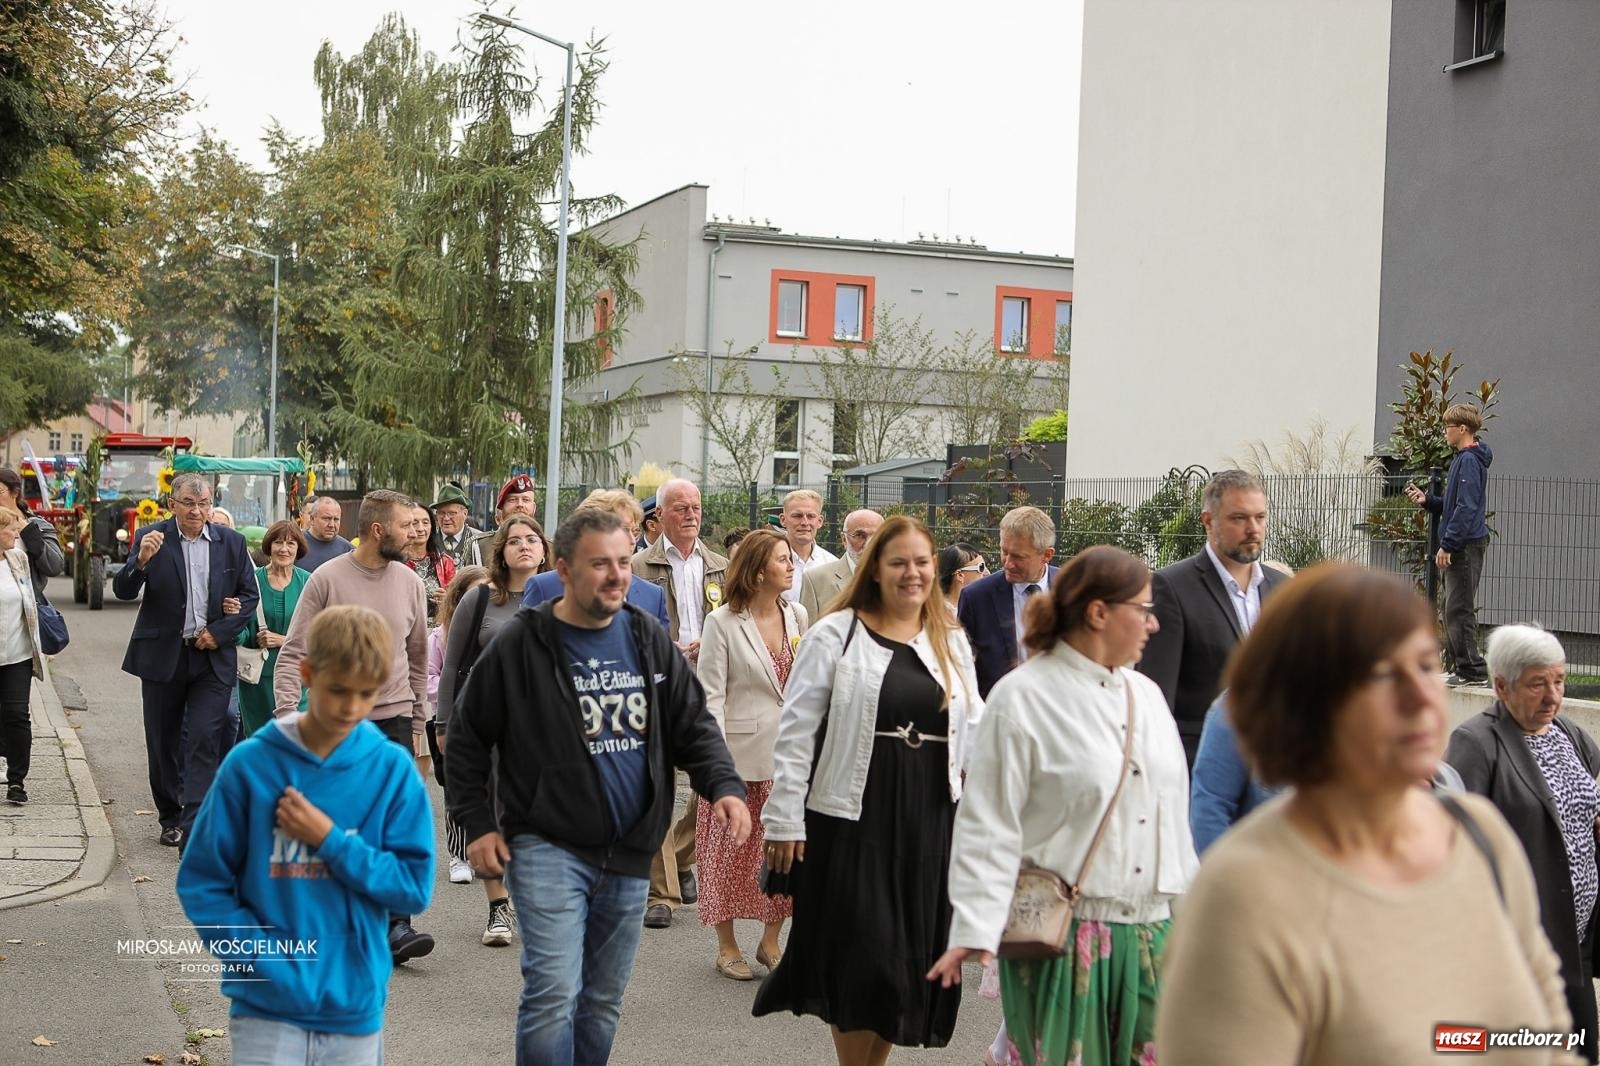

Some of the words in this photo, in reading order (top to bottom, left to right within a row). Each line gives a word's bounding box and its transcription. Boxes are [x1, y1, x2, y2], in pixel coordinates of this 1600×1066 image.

[573, 672, 600, 692] ited
[600, 670, 645, 691] Edition
[578, 692, 648, 735] 978
[588, 738, 638, 755] EDITION
